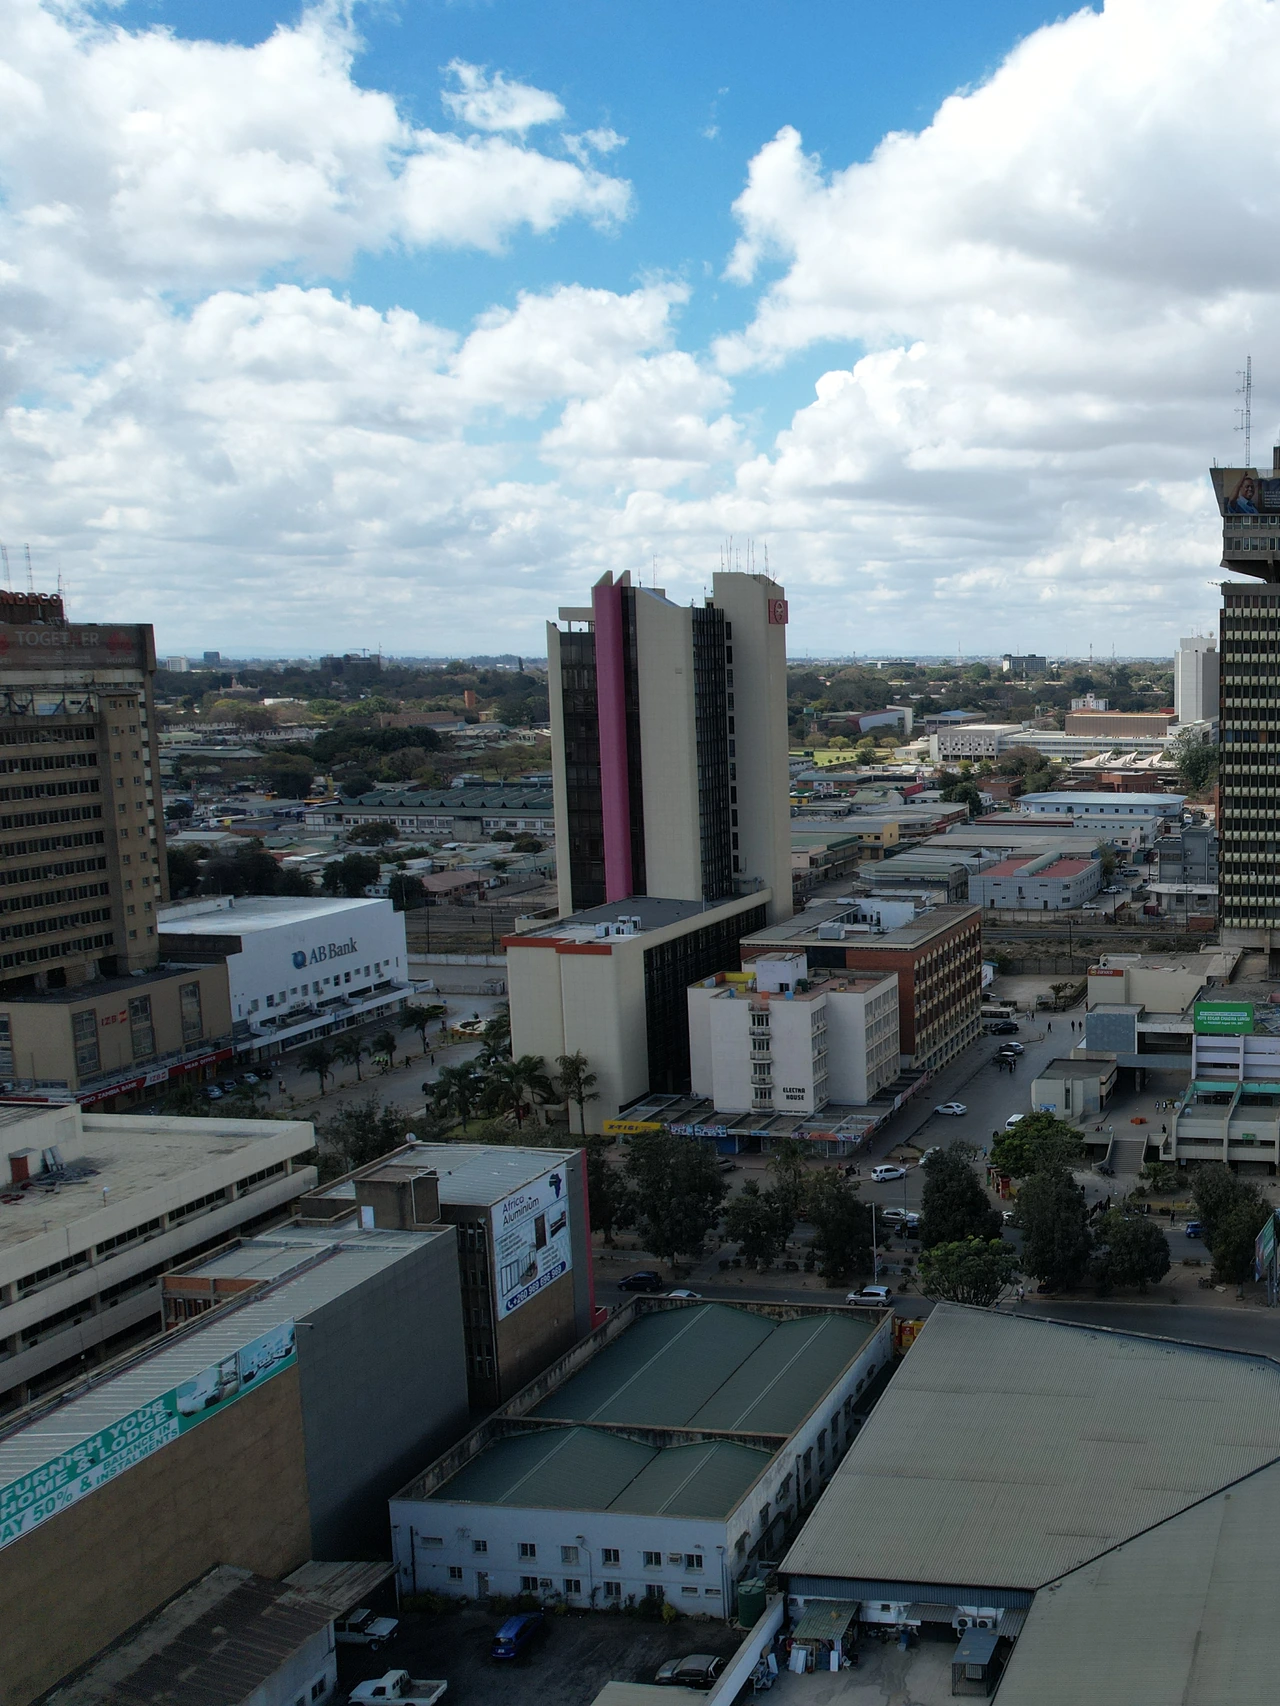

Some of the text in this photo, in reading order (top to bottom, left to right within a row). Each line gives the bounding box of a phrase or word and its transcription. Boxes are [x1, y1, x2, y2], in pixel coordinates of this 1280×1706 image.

[309, 937, 358, 965] AB Bank
[101, 1016, 117, 1026] IZB
[184, 1056, 216, 1071] HEAD OFFICE
[98, 1089, 121, 1100] ZAMBIA
[121, 1082, 138, 1092] BANK
[503, 1195, 525, 1214] Africa
[503, 1198, 540, 1226] Aluminium
[0, 1398, 166, 1506] FURNISH YOUR
[96, 1428, 179, 1485] INSTALMENTS
[103, 1422, 171, 1470] BALANCE IN
[0, 1468, 71, 1519] HOME
[98, 1413, 167, 1458] LODGE
[80, 1475, 93, 1494] &
[0, 1489, 74, 1544] AY 50%
